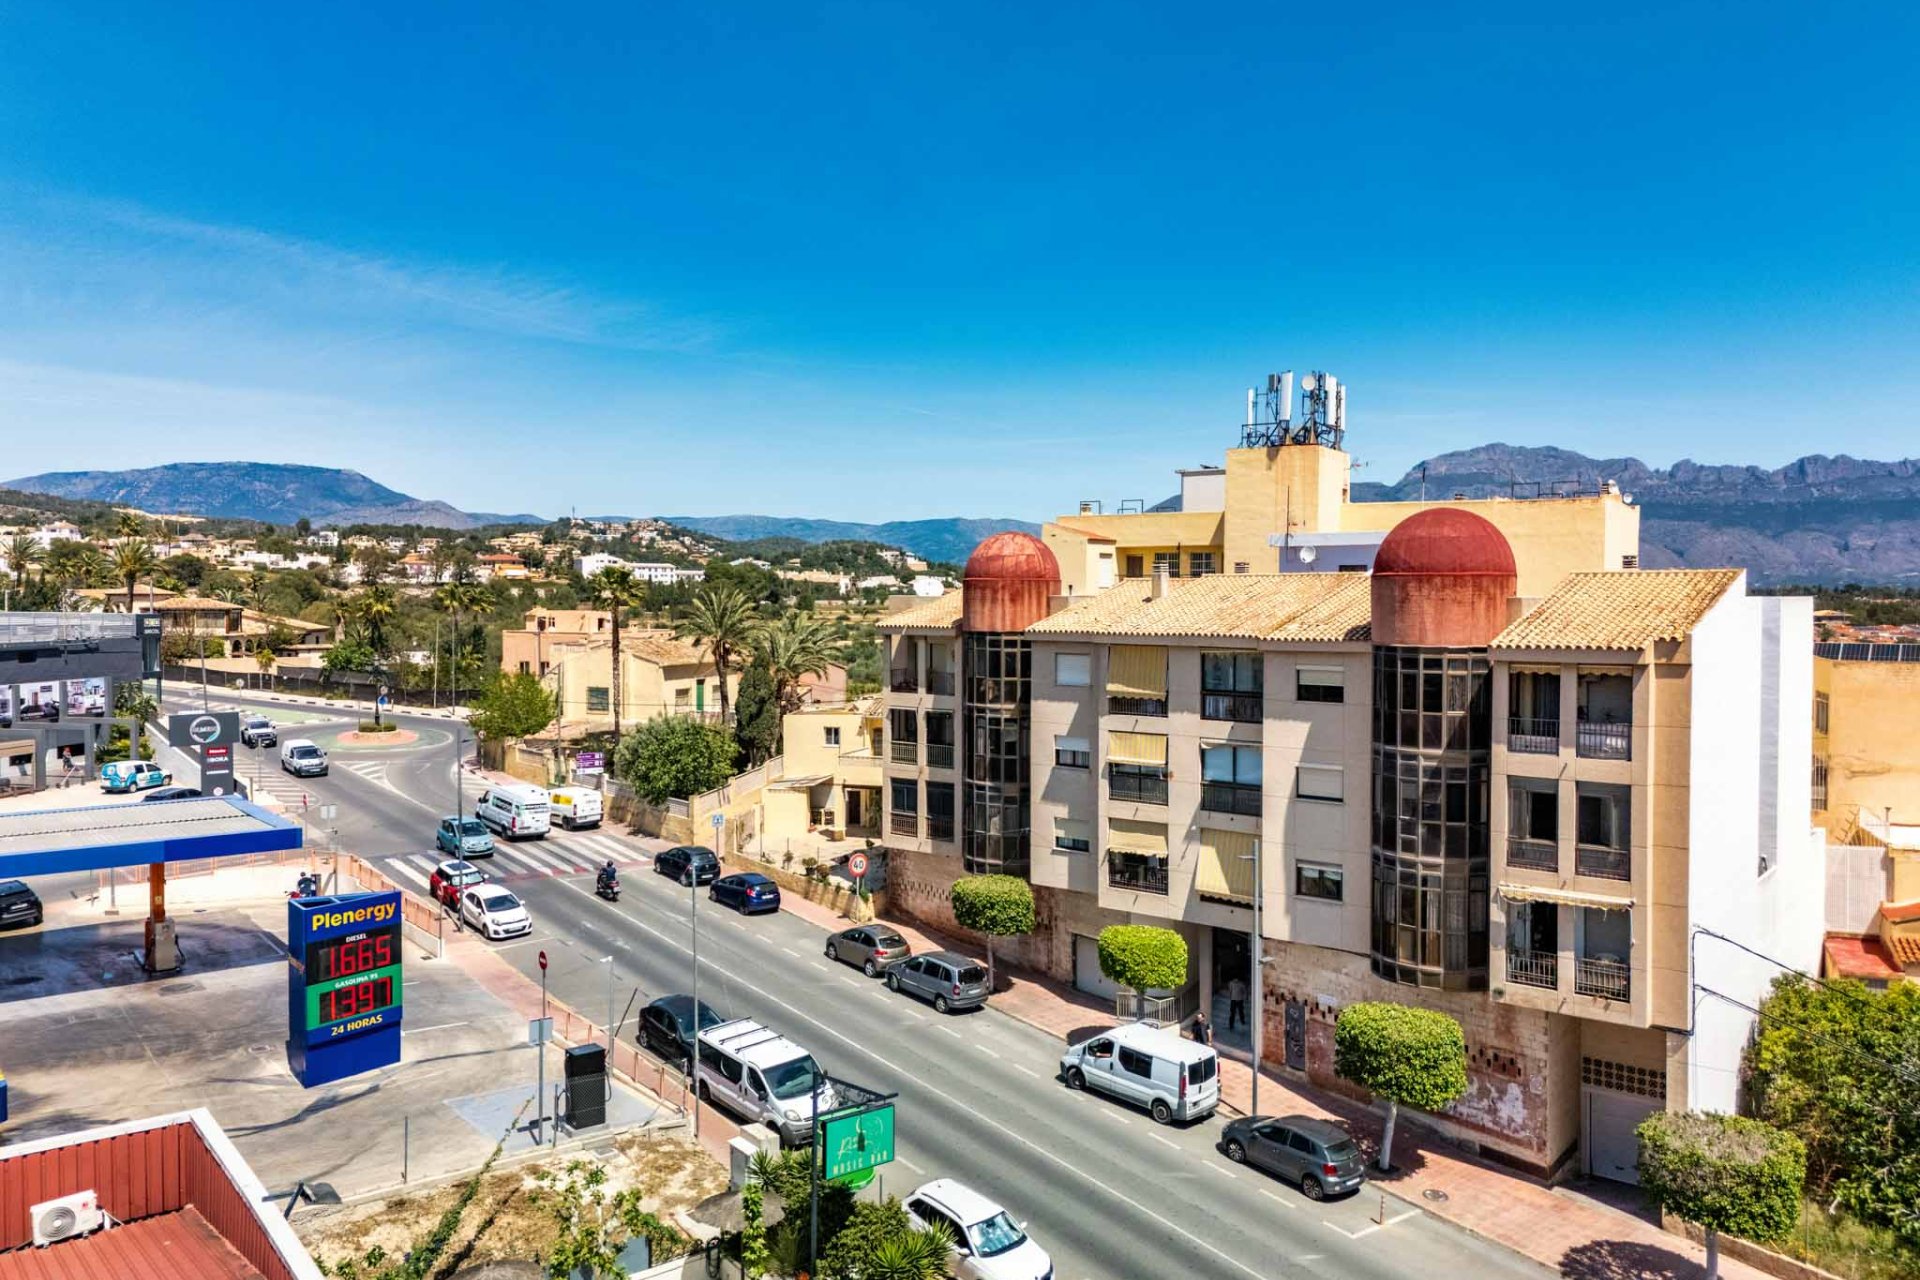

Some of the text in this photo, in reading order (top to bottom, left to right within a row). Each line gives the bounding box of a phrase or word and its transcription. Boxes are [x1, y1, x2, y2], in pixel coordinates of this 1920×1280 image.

[853, 860, 864, 870] 40
[312, 902, 395, 931] Plenergy
[345, 933, 367, 943] DIESEL
[334, 976, 369, 989] GASOLINA
[331, 1014, 382, 1036] 24 HORAS
